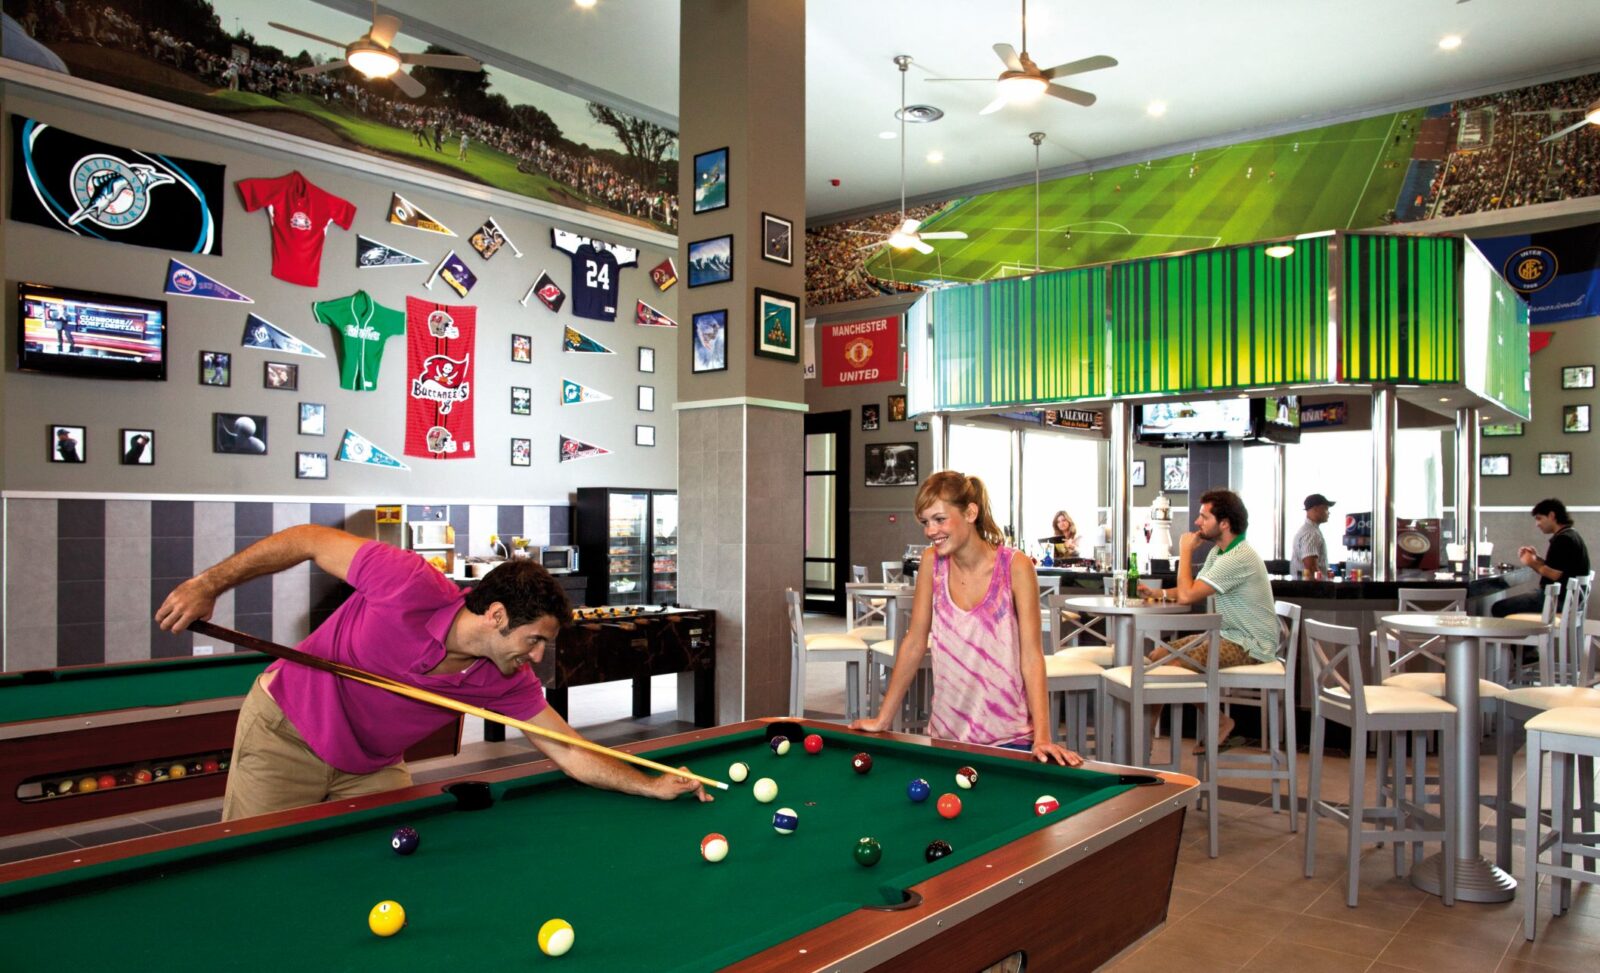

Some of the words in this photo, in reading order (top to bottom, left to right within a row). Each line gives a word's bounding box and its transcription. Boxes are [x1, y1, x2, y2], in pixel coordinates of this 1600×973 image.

[77, 160, 122, 203] FLORIDA
[109, 177, 144, 224] MARLINS
[1520, 249, 1543, 258] INTER
[586, 260, 610, 290] 24
[832, 319, 888, 337] MANCHESTER
[839, 368, 880, 382] UNITED
[1059, 409, 1093, 422] VALENCIA
